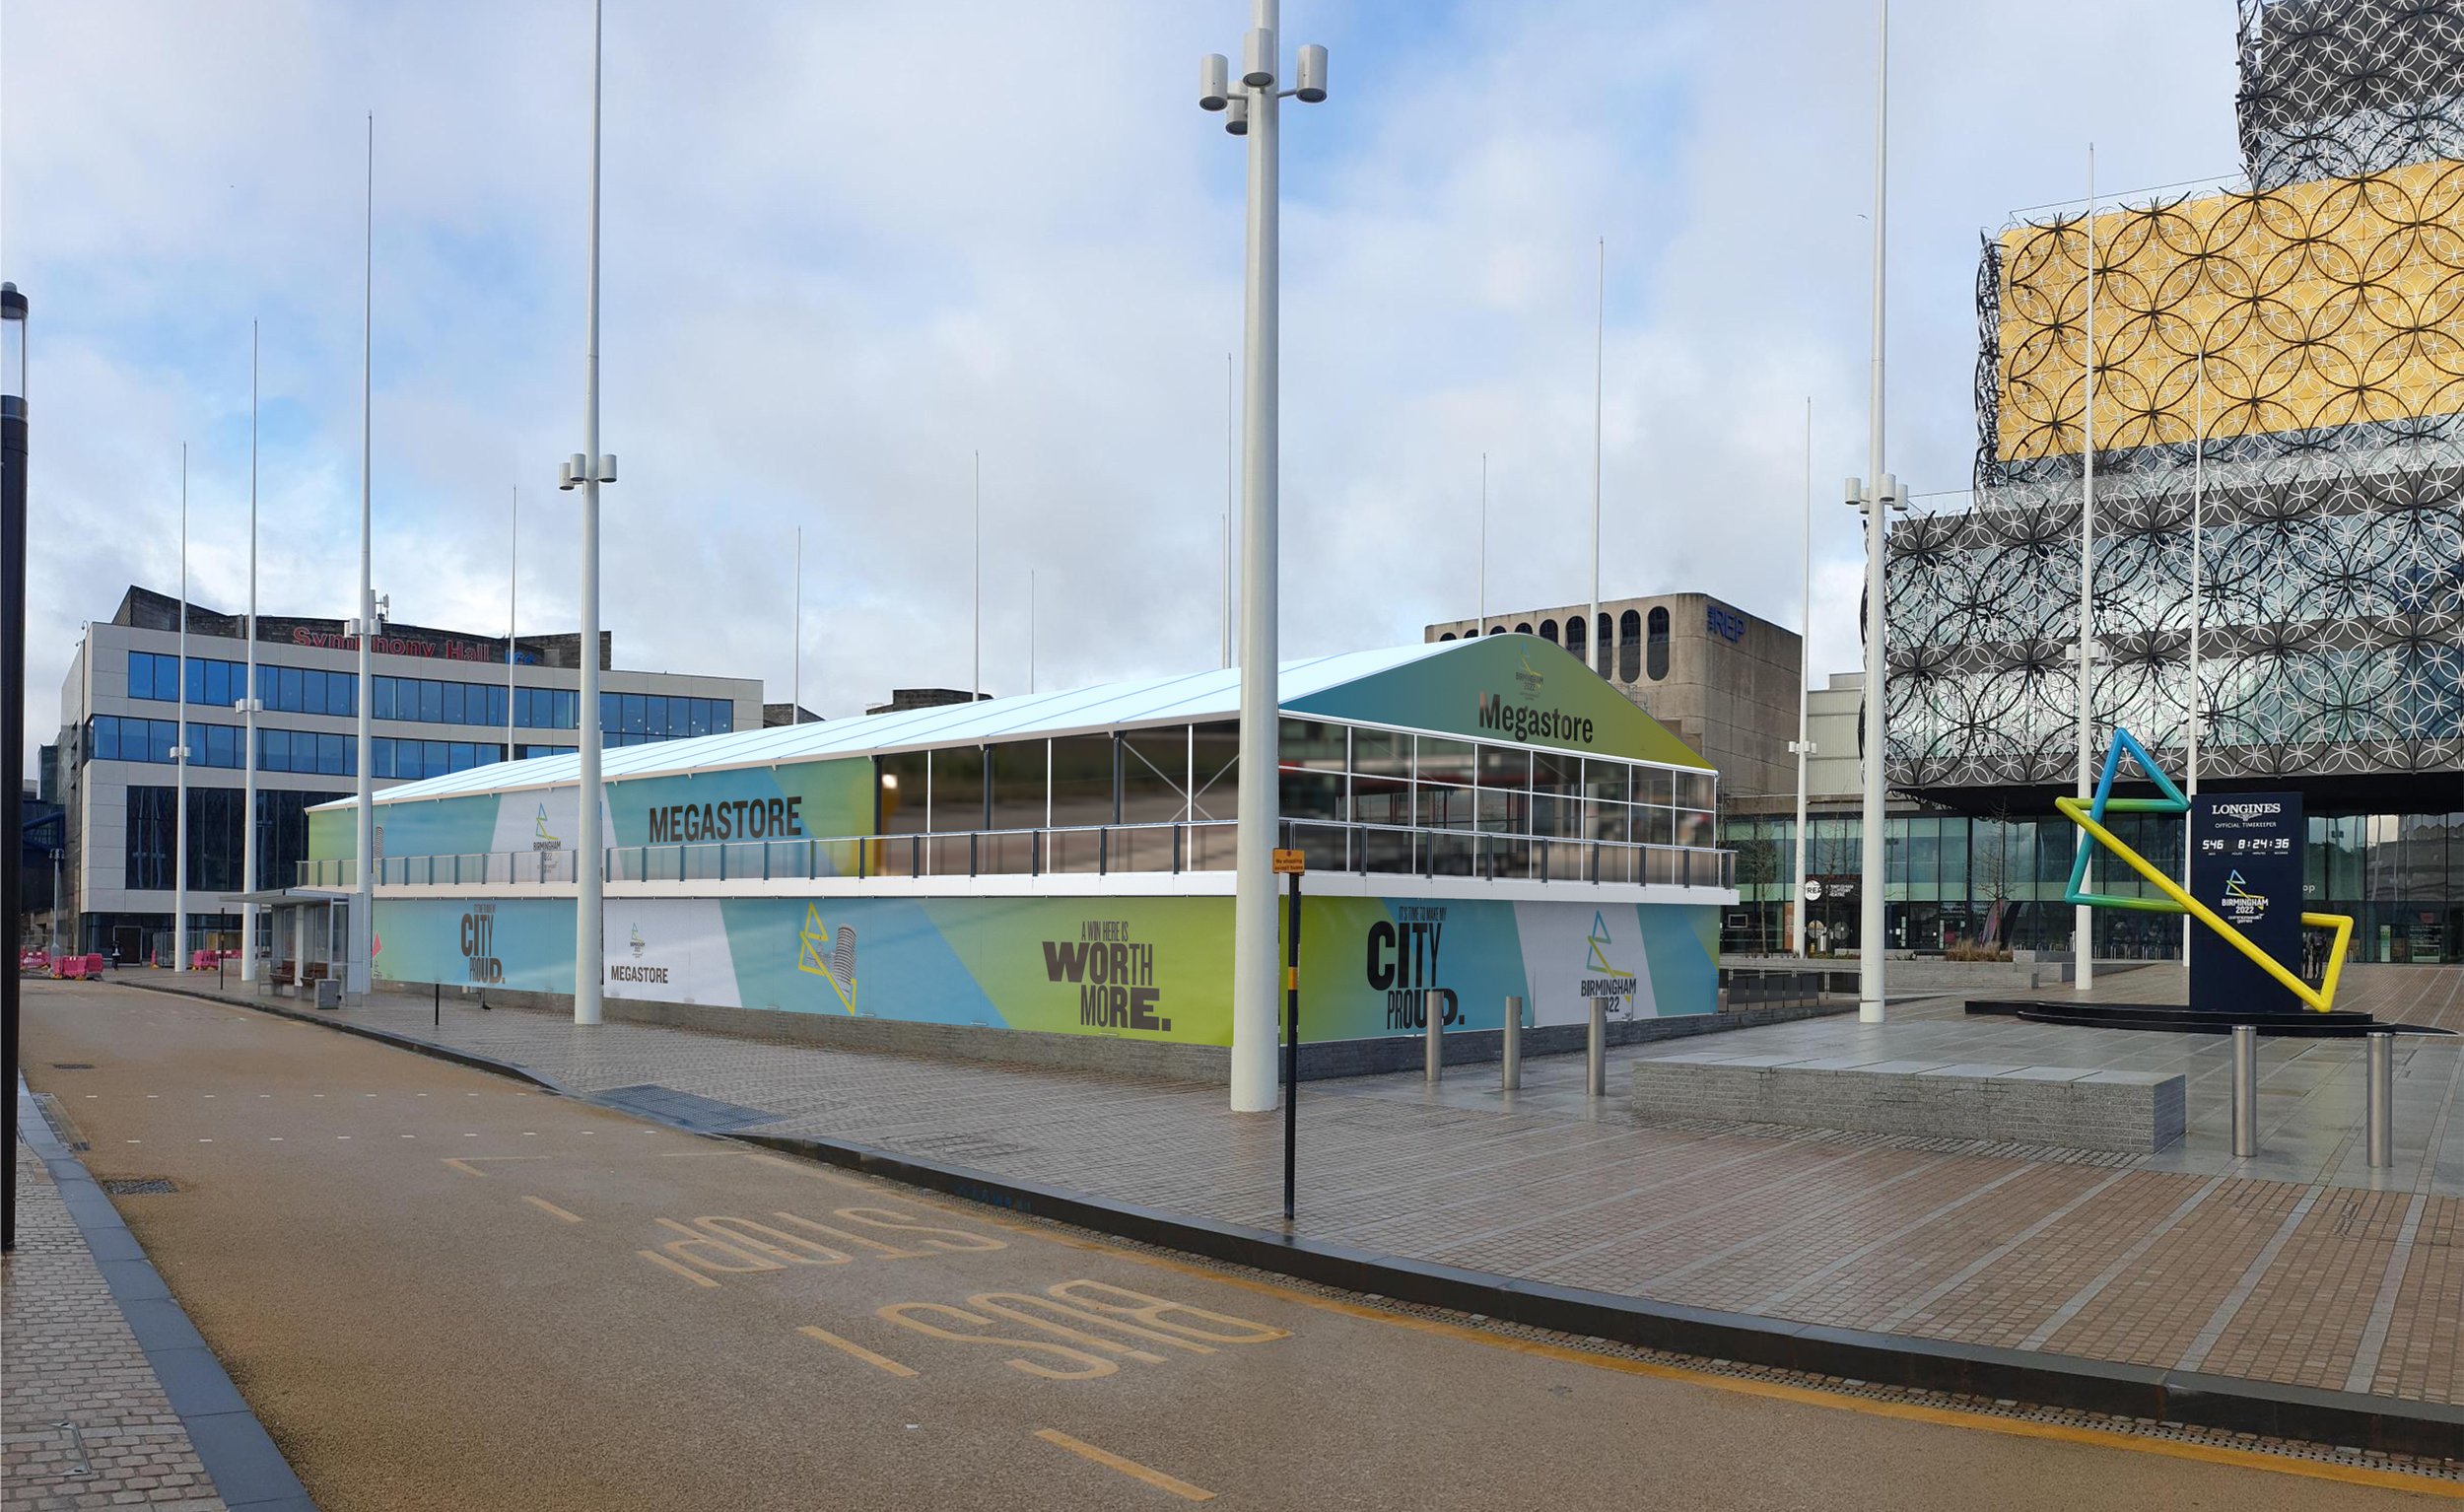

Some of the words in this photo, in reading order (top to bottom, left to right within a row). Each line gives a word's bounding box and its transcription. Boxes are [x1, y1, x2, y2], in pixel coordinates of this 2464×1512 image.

[445, 639, 490, 662] Hall
[1479, 691, 1594, 743] Megastore
[650, 795, 802, 843] MEGASTORE
[2212, 803, 2281, 815] LONGINES
[2202, 839, 2224, 851] 546
[2222, 898, 2269, 907] BIRMINGHAM
[2235, 906, 2255, 915] 2022
[460, 913, 494, 958] CITY
[1081, 921, 1086, 941] A
[1087, 921, 1102, 941] WIN
[1102, 921, 1121, 941] HERE
[1121, 921, 1129, 941] IS
[468, 956, 506, 984] PROUD.
[1042, 940, 1153, 987] WORTH
[1366, 920, 1442, 992] CITY
[610, 965, 668, 984] MEGASTORE
[1581, 978, 1637, 997] BIRMINGHAM
[1080, 984, 1172, 1032] MORE.
[1387, 988, 1465, 1030] PROUD.
[875, 1279, 1293, 1380] BUS
